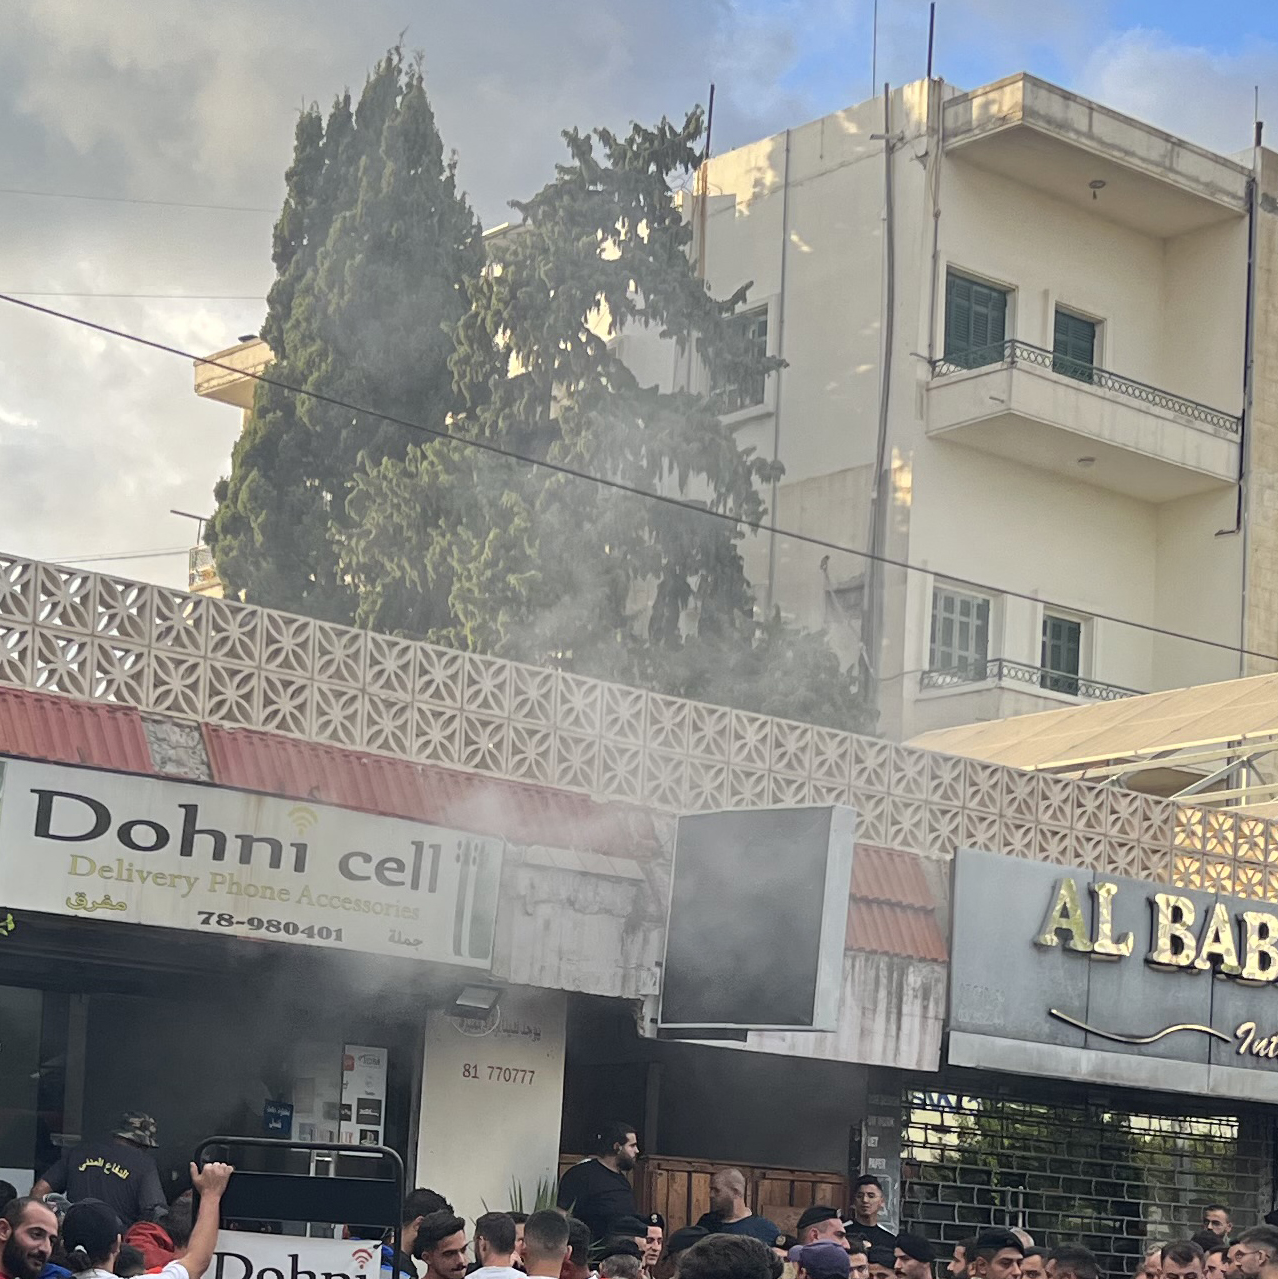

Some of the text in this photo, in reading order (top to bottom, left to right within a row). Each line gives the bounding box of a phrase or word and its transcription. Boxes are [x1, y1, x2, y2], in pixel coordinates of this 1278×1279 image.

[29, 787, 443, 894] Dohni cell
[66, 891, 128, 912] مفرق
[67, 853, 421, 921] Delivery Phone Accessories
[197, 910, 344, 943] 78-980401
[1035, 876, 1135, 960] AL
[462, 1063, 535, 1085] 81 770777
